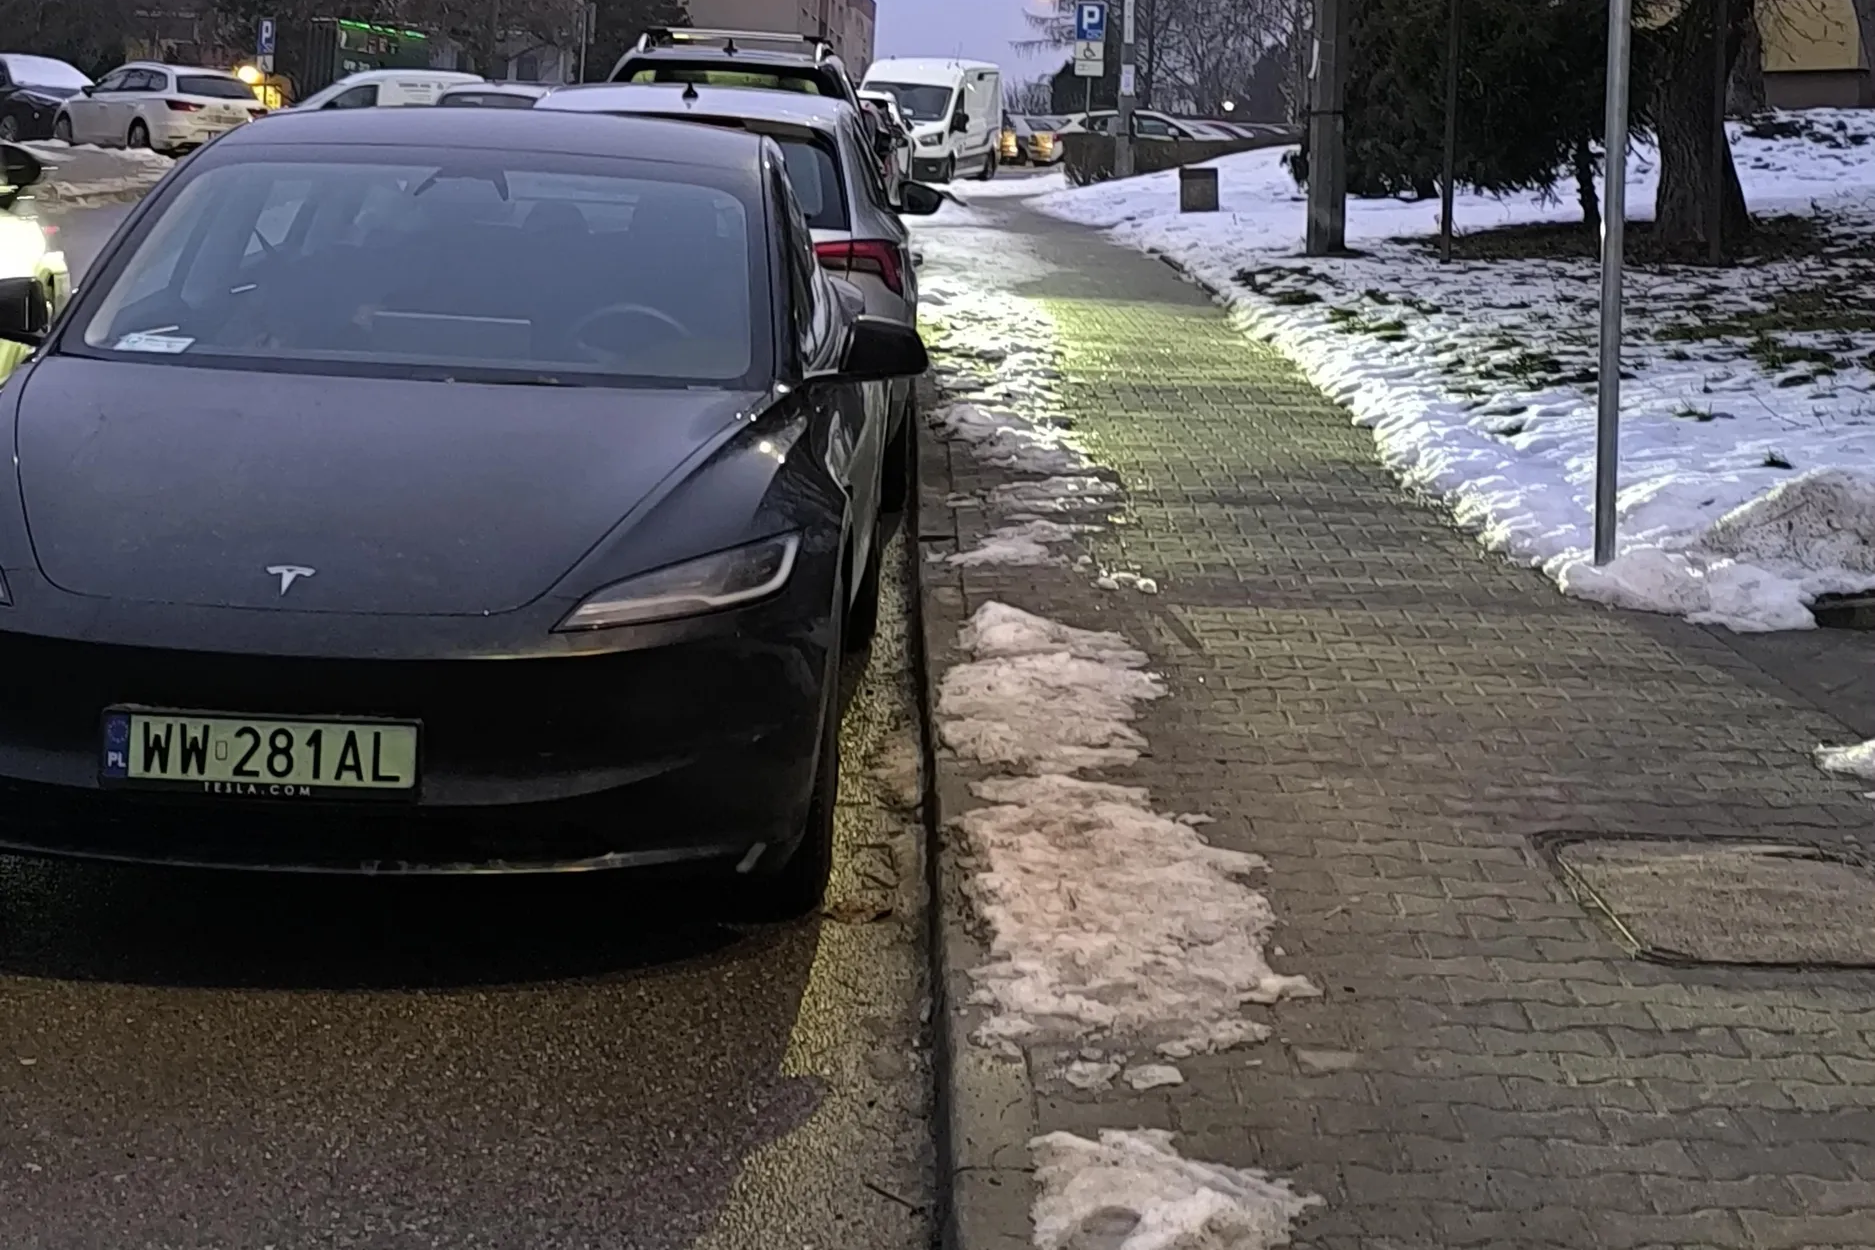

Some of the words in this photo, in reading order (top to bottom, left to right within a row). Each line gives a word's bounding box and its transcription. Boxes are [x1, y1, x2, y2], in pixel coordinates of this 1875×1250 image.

[1083, 5, 1101, 30] P
[107, 751, 127, 769] PL
[143, 721, 210, 776] WW
[232, 726, 401, 783] 281AL
[204, 781, 311, 797] TESLA.COM
